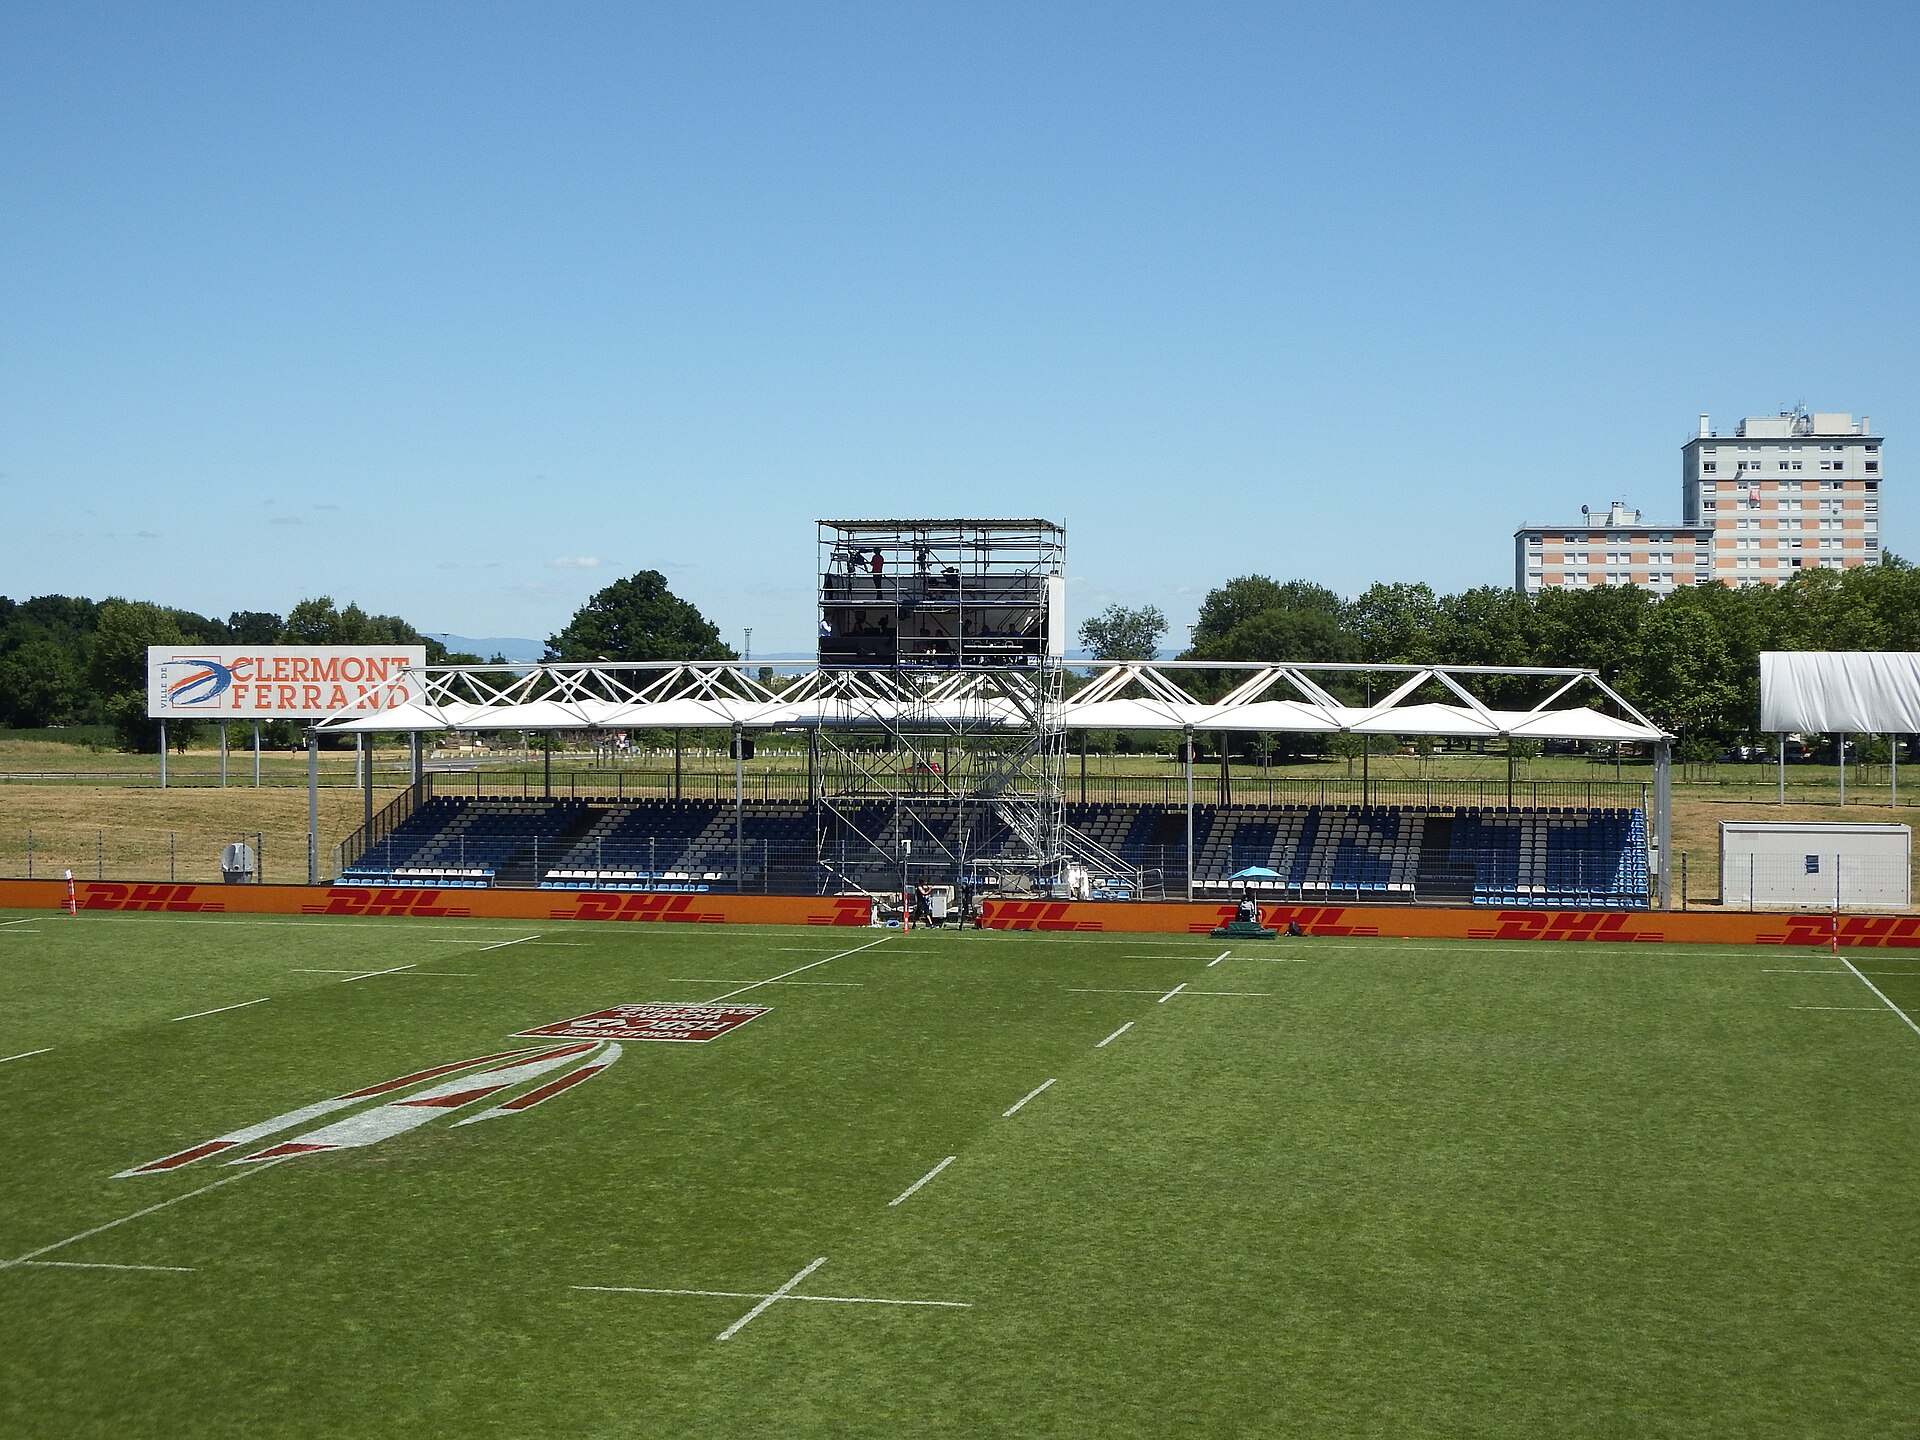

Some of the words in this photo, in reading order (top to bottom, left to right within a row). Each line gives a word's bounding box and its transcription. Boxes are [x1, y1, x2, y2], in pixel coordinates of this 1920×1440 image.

[160, 667, 167, 679] DE
[231, 656, 410, 683] CLERMONT
[231, 684, 410, 710] FERRAND
[83, 883, 203, 912] DHL
[324, 888, 450, 918] DHL
[573, 893, 702, 923] DHL
[983, 901, 1077, 931] HL
[1494, 911, 1637, 943] DHL
[1782, 916, 1920, 948] DHL
[617, 1020, 735, 1032] HSBC
[618, 1030, 691, 1038] WORLD
